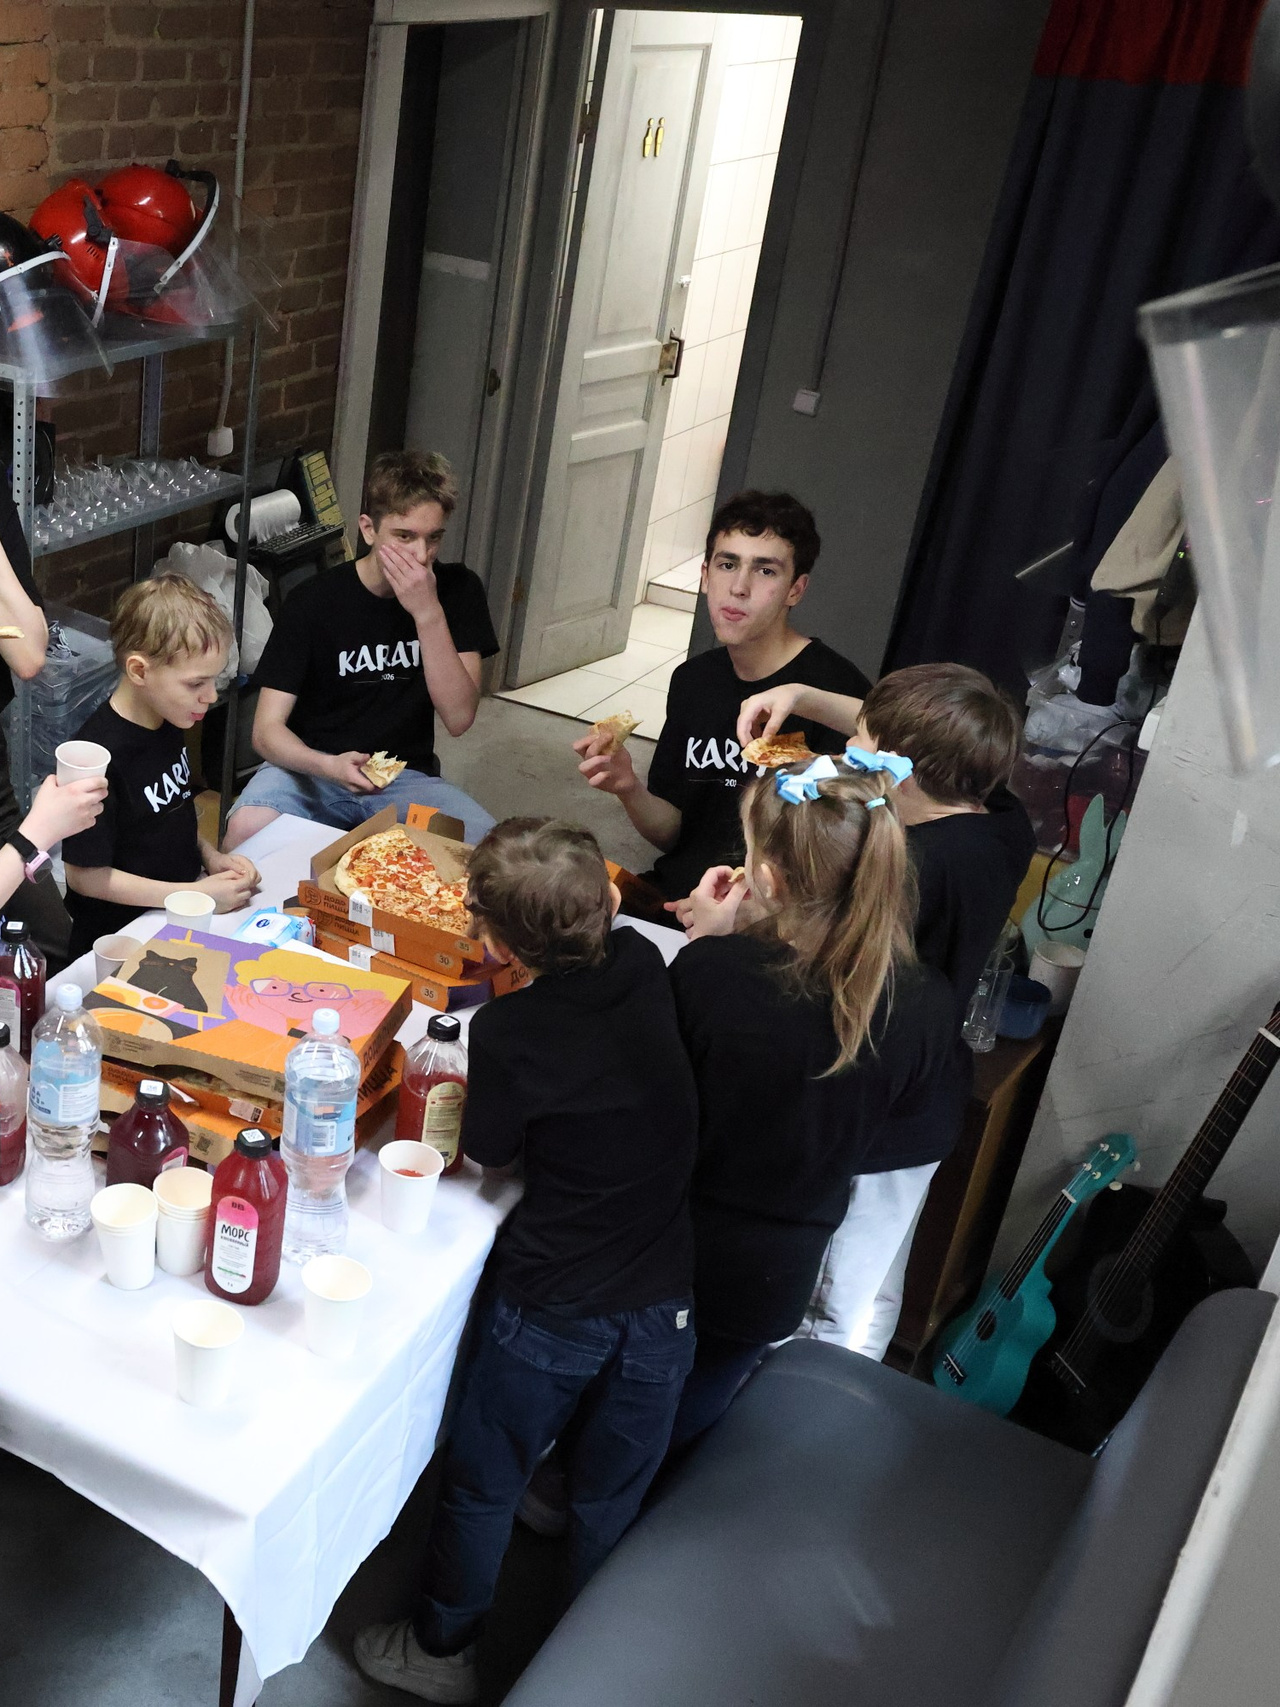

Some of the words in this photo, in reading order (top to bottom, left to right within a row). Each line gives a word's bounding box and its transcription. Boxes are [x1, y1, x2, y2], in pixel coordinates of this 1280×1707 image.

[439, 955, 450, 965] 30
[424, 988, 434, 999] 35
[221, 1224, 251, 1243] МОРС
